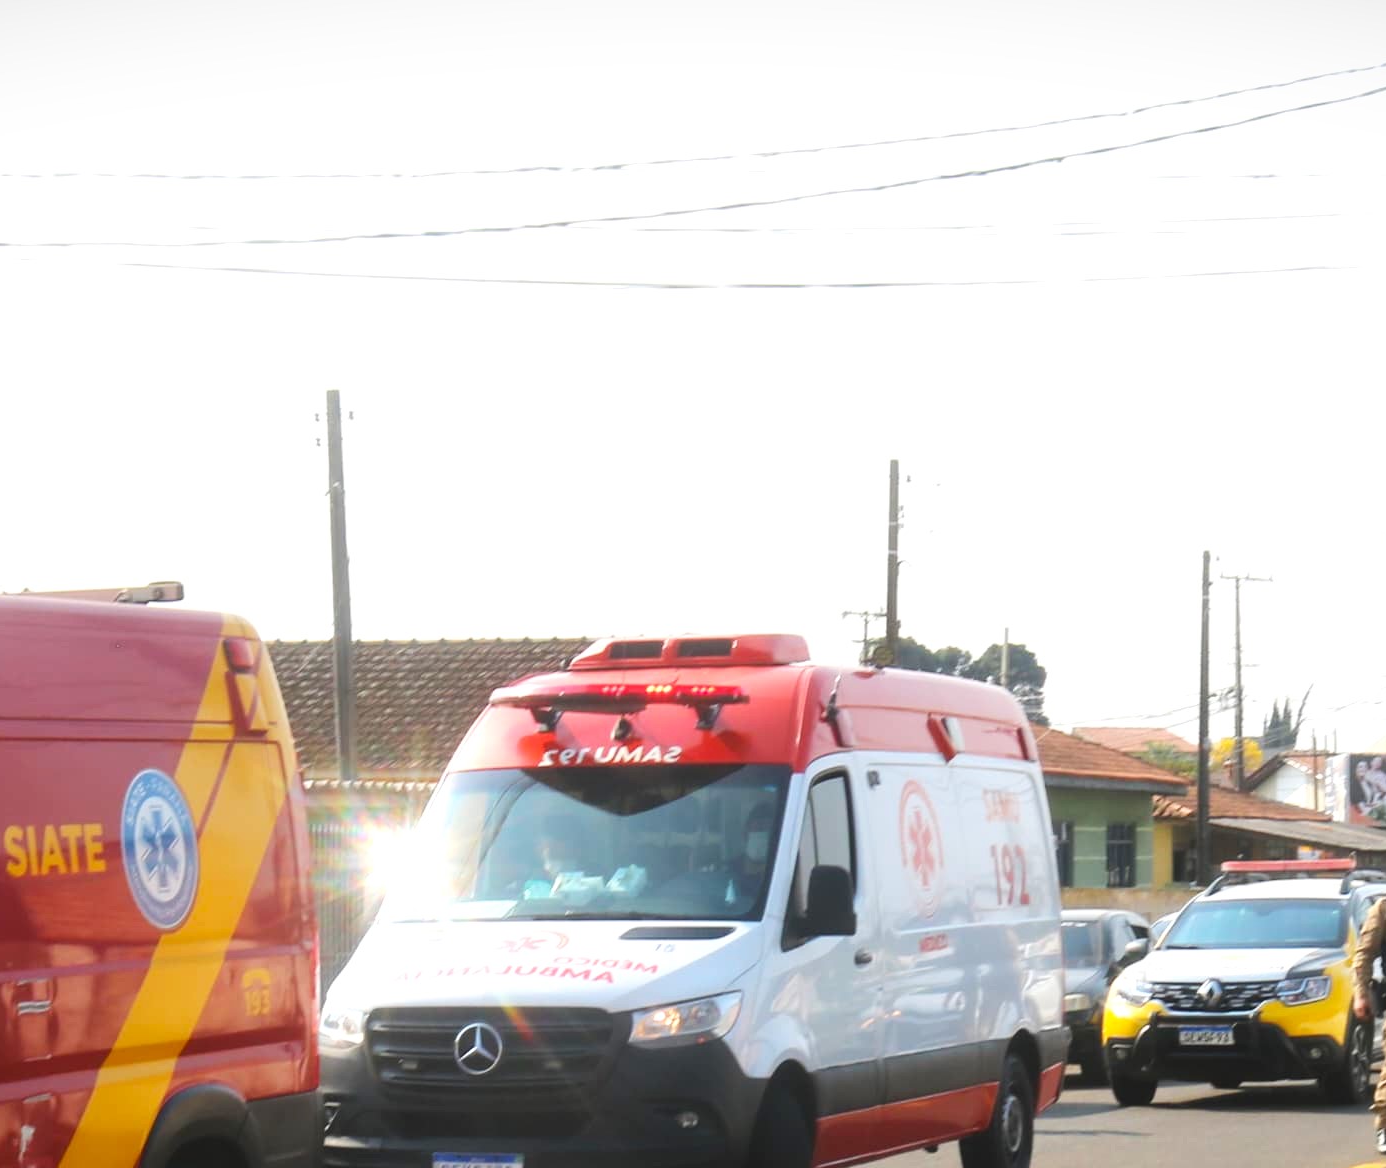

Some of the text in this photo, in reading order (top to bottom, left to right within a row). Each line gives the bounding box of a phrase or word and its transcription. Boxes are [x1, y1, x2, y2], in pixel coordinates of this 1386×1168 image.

[4, 823, 107, 877] SIATE
[990, 844, 1031, 906] 192
[244, 988, 270, 1017] 193
